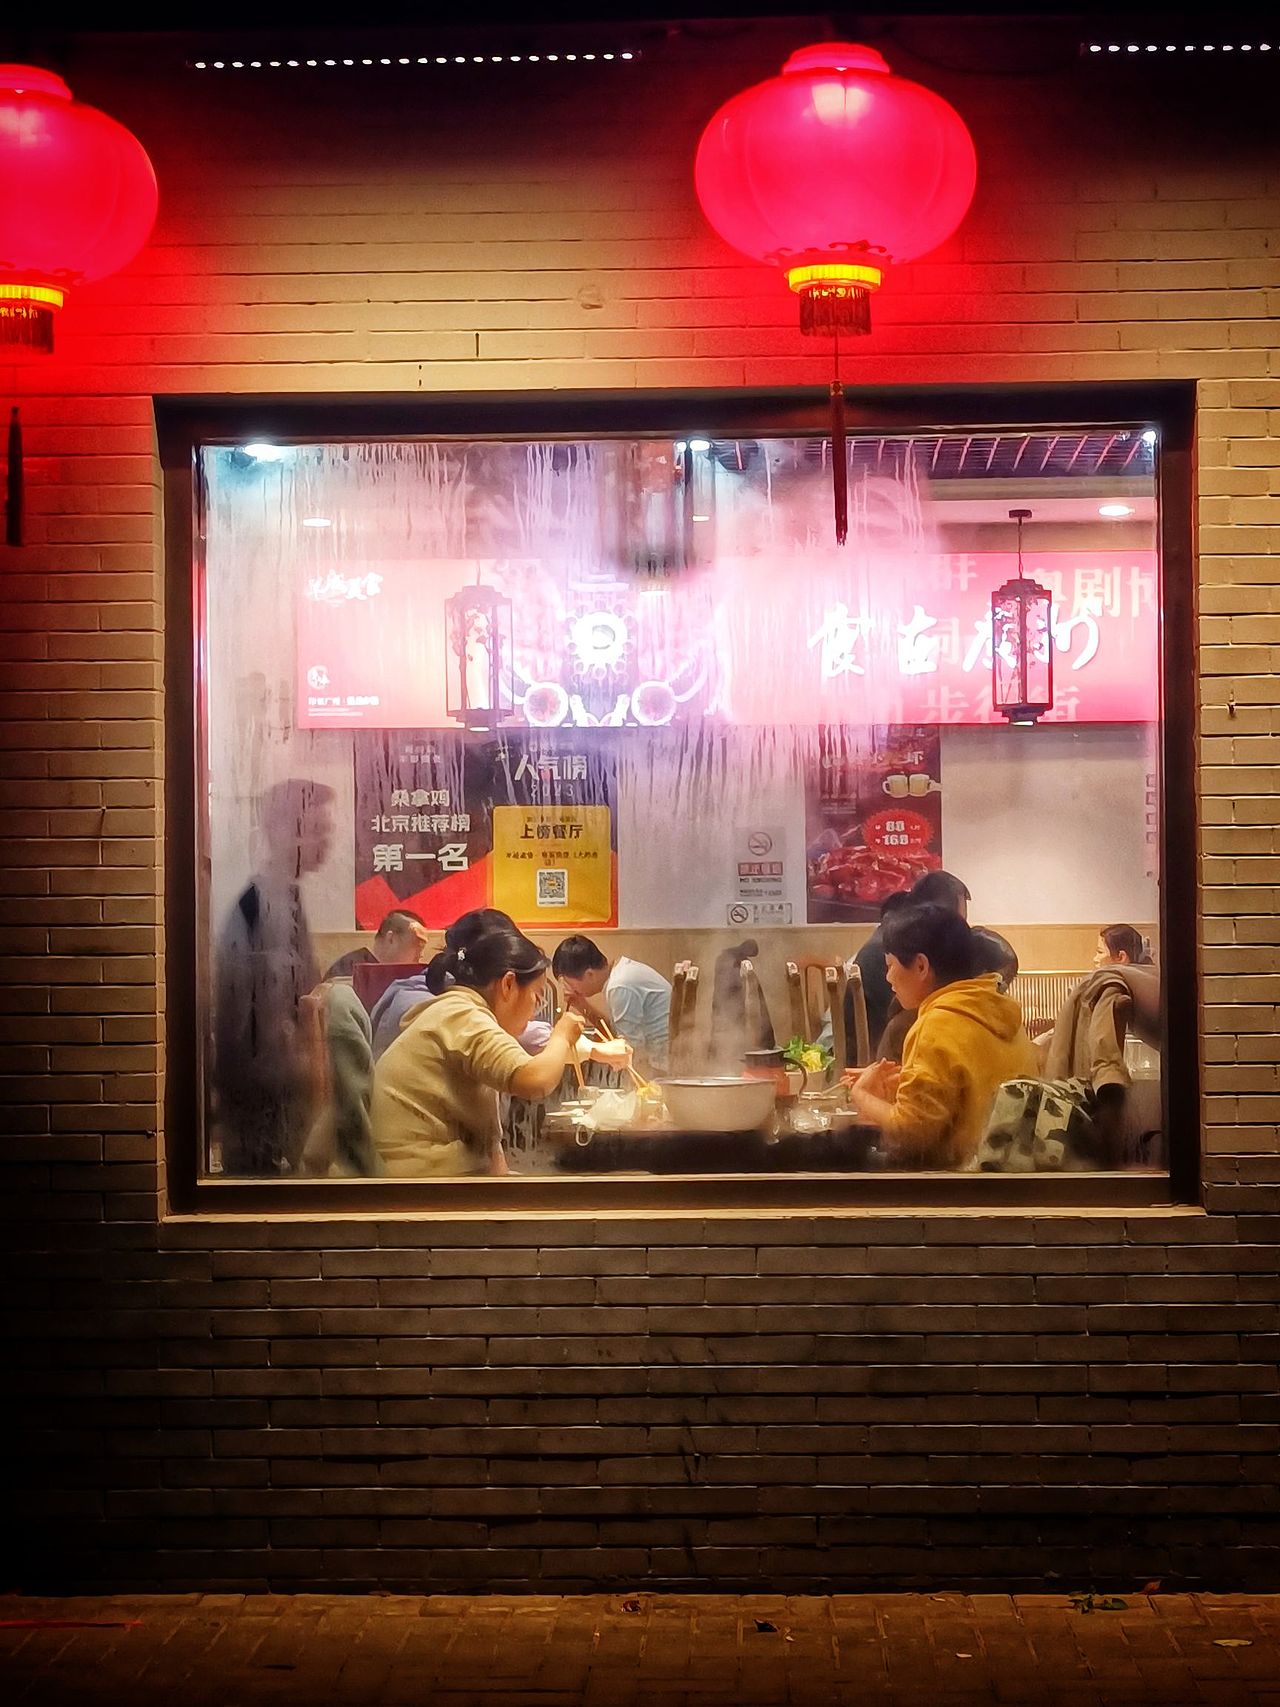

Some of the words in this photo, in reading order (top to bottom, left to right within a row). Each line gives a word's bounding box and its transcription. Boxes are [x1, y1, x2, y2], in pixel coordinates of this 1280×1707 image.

[514, 754, 587, 781] 人气榜
[371, 813, 471, 834] 北京推荐榜
[520, 824, 584, 840] 上榜餐厅
[373, 843, 469, 872] 第一名
